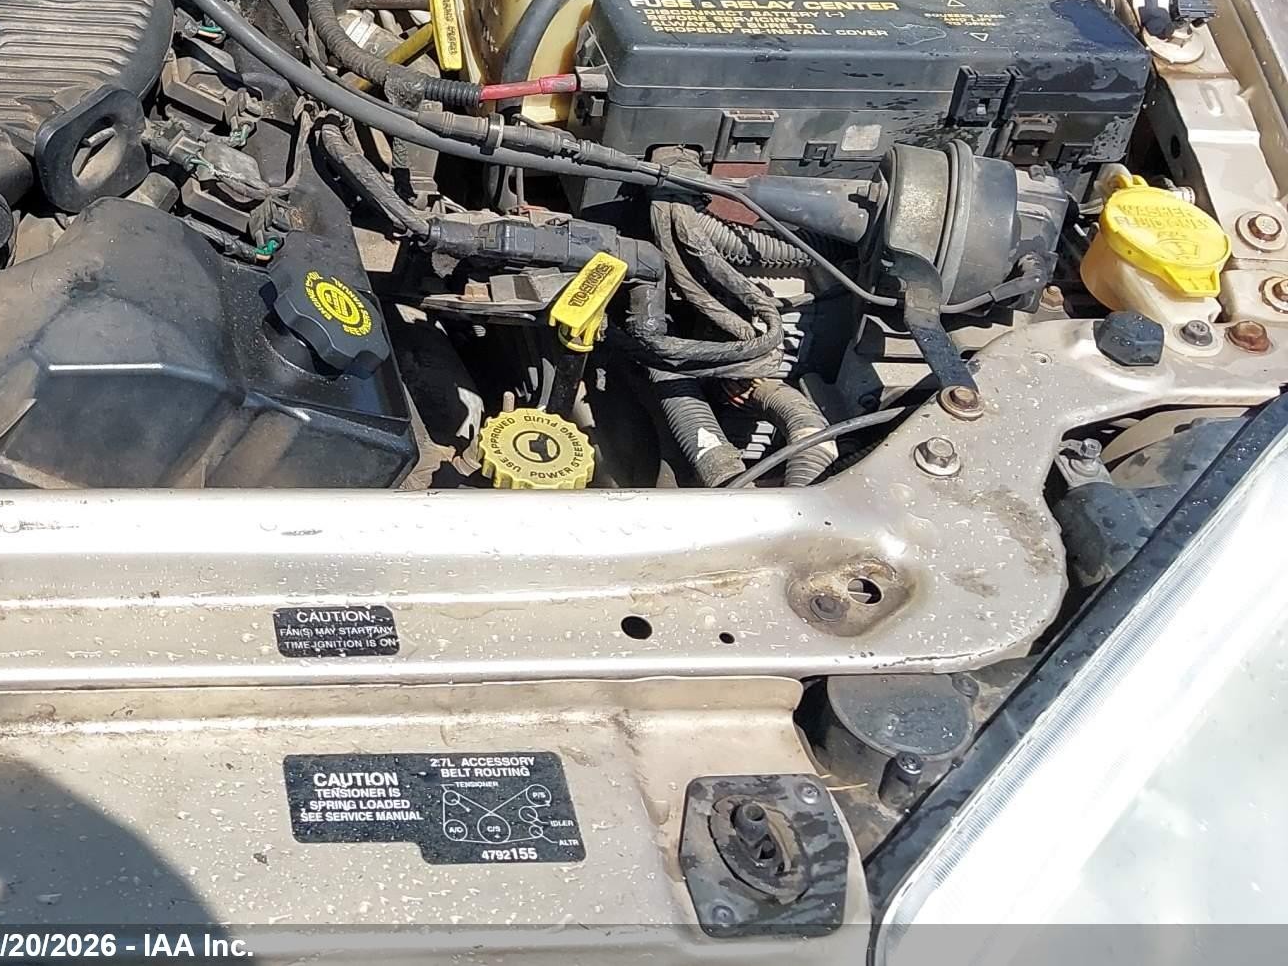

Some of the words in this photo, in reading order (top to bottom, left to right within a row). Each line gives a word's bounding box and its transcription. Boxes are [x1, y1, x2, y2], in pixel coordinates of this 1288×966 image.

[700, 0, 717, 8] &
[720, 0, 796, 10] RELAY
[803, 1, 900, 11] CENTER
[650, 20, 716, 28] ALWAYS
[653, 26, 734, 34] PROPERLY
[741, 28, 832, 36] RE-INSTALL
[330, 276, 364, 308] MANUAL
[305, 286, 332, 320] ENGINE
[523, 414, 559, 428] FLUID
[490, 417, 516, 456] APPROVED
[560, 426, 584, 469] STEERING
[499, 456, 522, 474] USE
[529, 466, 574, 480] POWER
[296, 610, 371, 623] CAUTION
[280, 628, 313, 638] FAN(S)
[315, 627, 336, 636] MAY
[338, 626, 371, 635] START
[372, 626, 394, 634] ANY
[284, 641, 310, 649] TIME
[312, 640, 363, 649] IGNITION
[366, 639, 377, 648] IS
[379, 638, 397, 647] ON
[430, 758, 456, 767] 2.7L
[461, 757, 535, 767] ACCESSORY
[440, 768, 471, 778] BELT
[474, 767, 530, 777] ROUTING
[313, 772, 399, 787] CAUTION
[314, 788, 386, 798] TENSIONER
[389, 787, 401, 798] IS
[310, 800, 357, 810] SPRING
[359, 800, 411, 809] LOADED
[300, 812, 324, 822] SEE
[325, 812, 374, 822] SERVICE
[376, 811, 424, 821] MANUAL
[481, 847, 538, 860] 4792155
